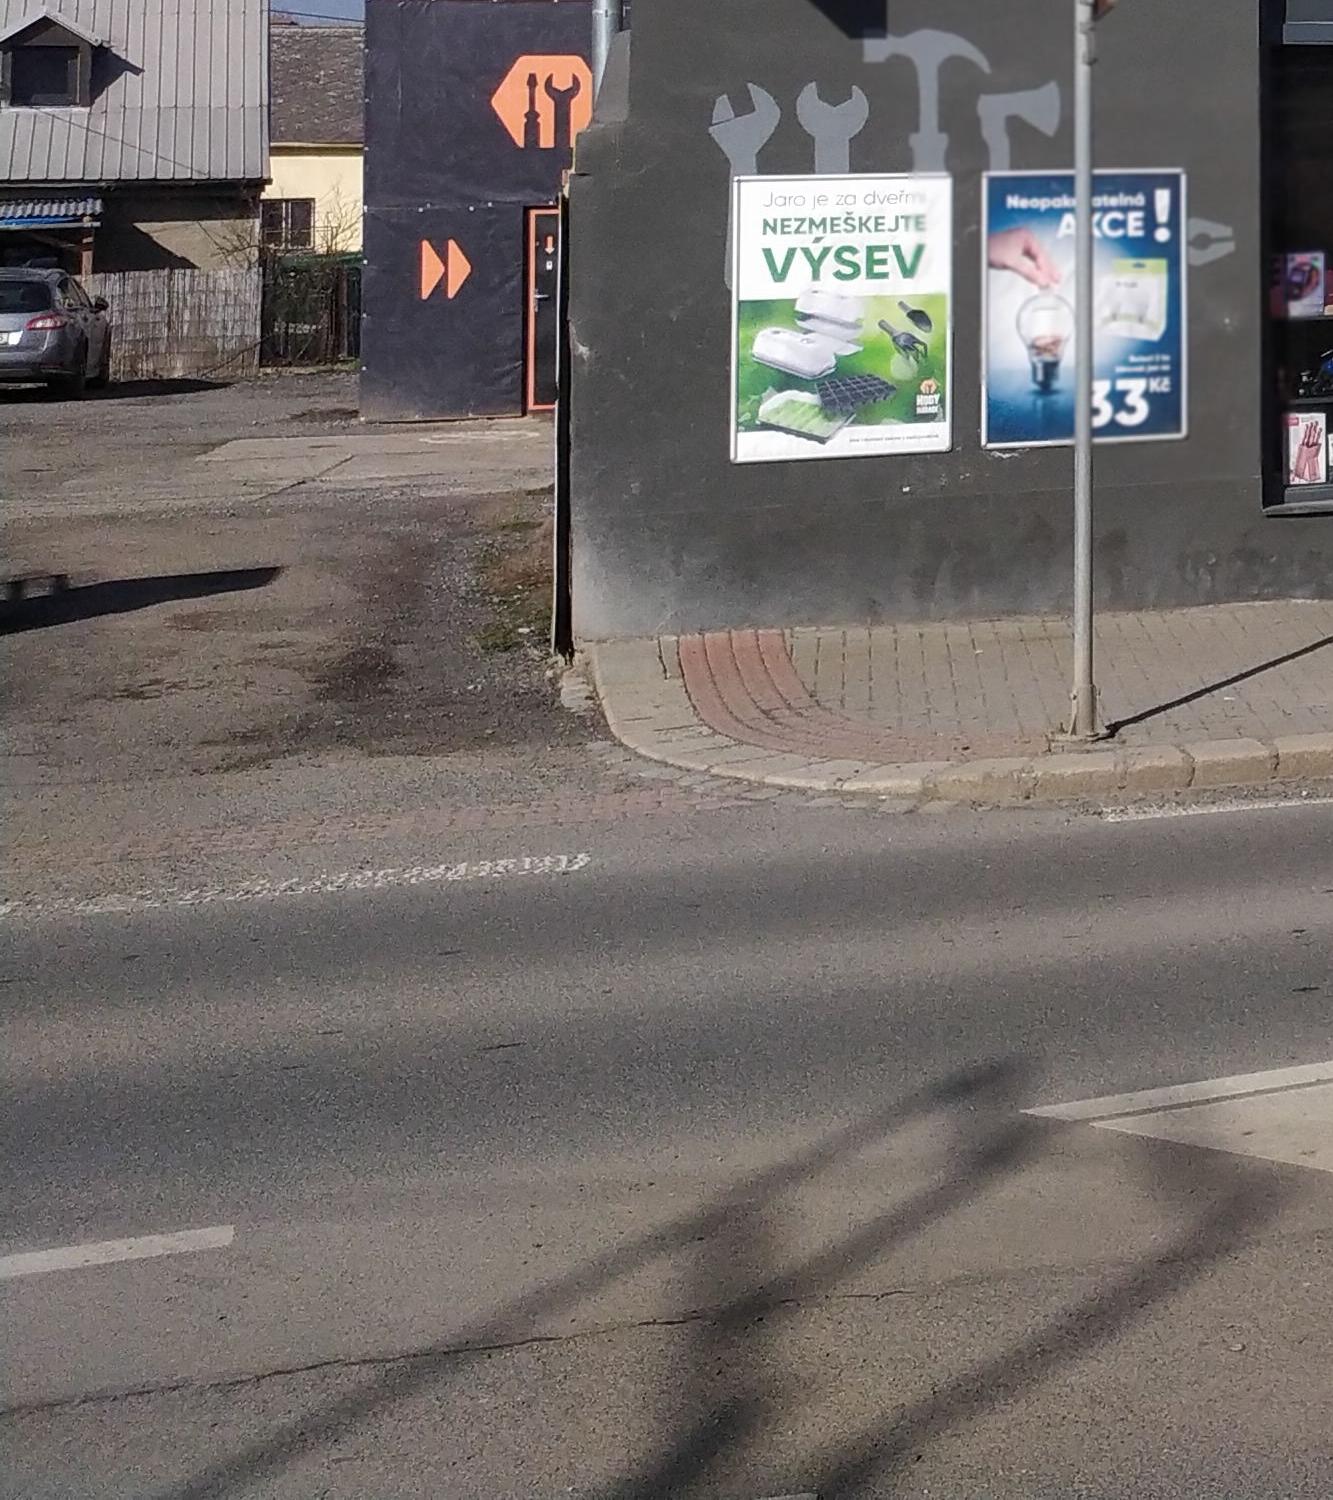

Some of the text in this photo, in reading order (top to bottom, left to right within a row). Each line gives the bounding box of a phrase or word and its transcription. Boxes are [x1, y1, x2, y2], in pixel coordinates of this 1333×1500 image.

[763, 192, 806, 207] Jaro
[812, 192, 829, 210] je
[836, 194, 857, 206] za
[1006, 192, 1145, 212] Neopakatelná
[762, 211, 927, 235] NEZMEŠKEJTE
[762, 236, 926, 283] VÝSEV
